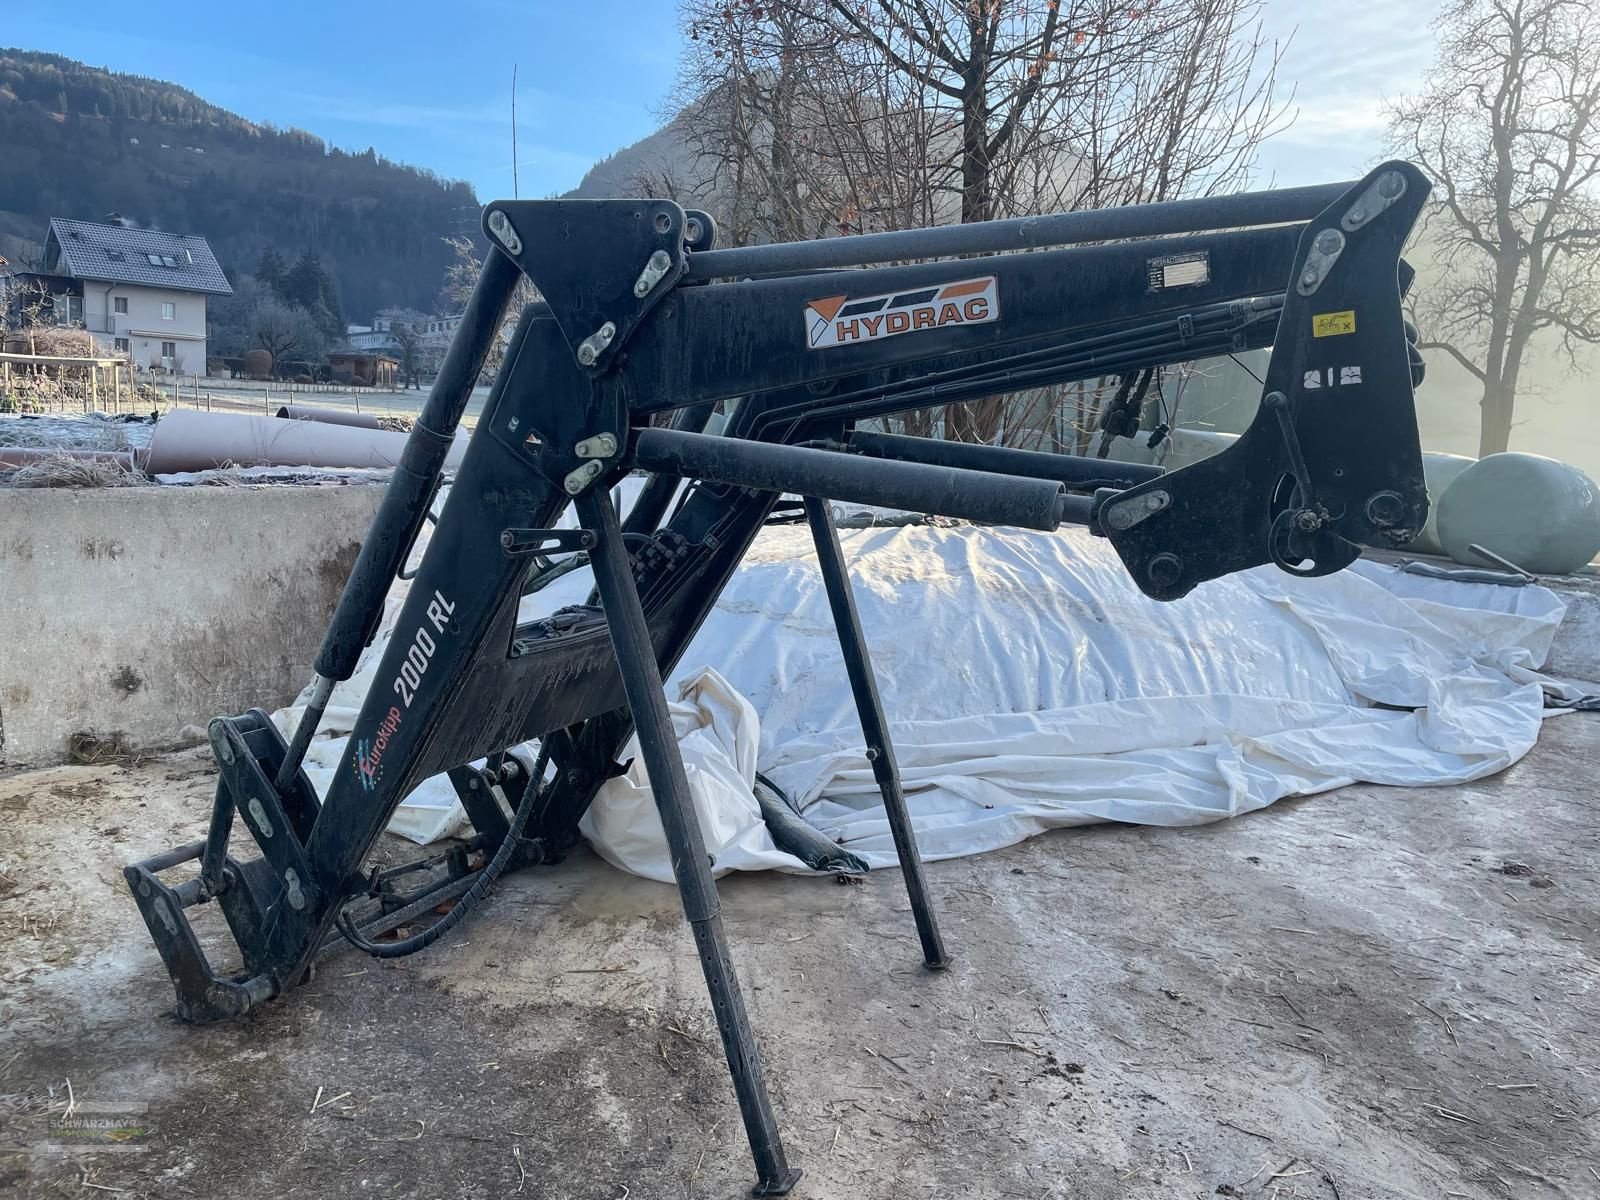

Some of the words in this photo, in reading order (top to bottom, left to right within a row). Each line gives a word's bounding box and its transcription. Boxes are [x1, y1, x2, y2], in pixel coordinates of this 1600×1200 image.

[836, 297, 989, 342] HYDRAC
[359, 706, 402, 777] Eurokipp
[393, 626, 436, 709] 2000
[426, 589, 456, 635] RL
